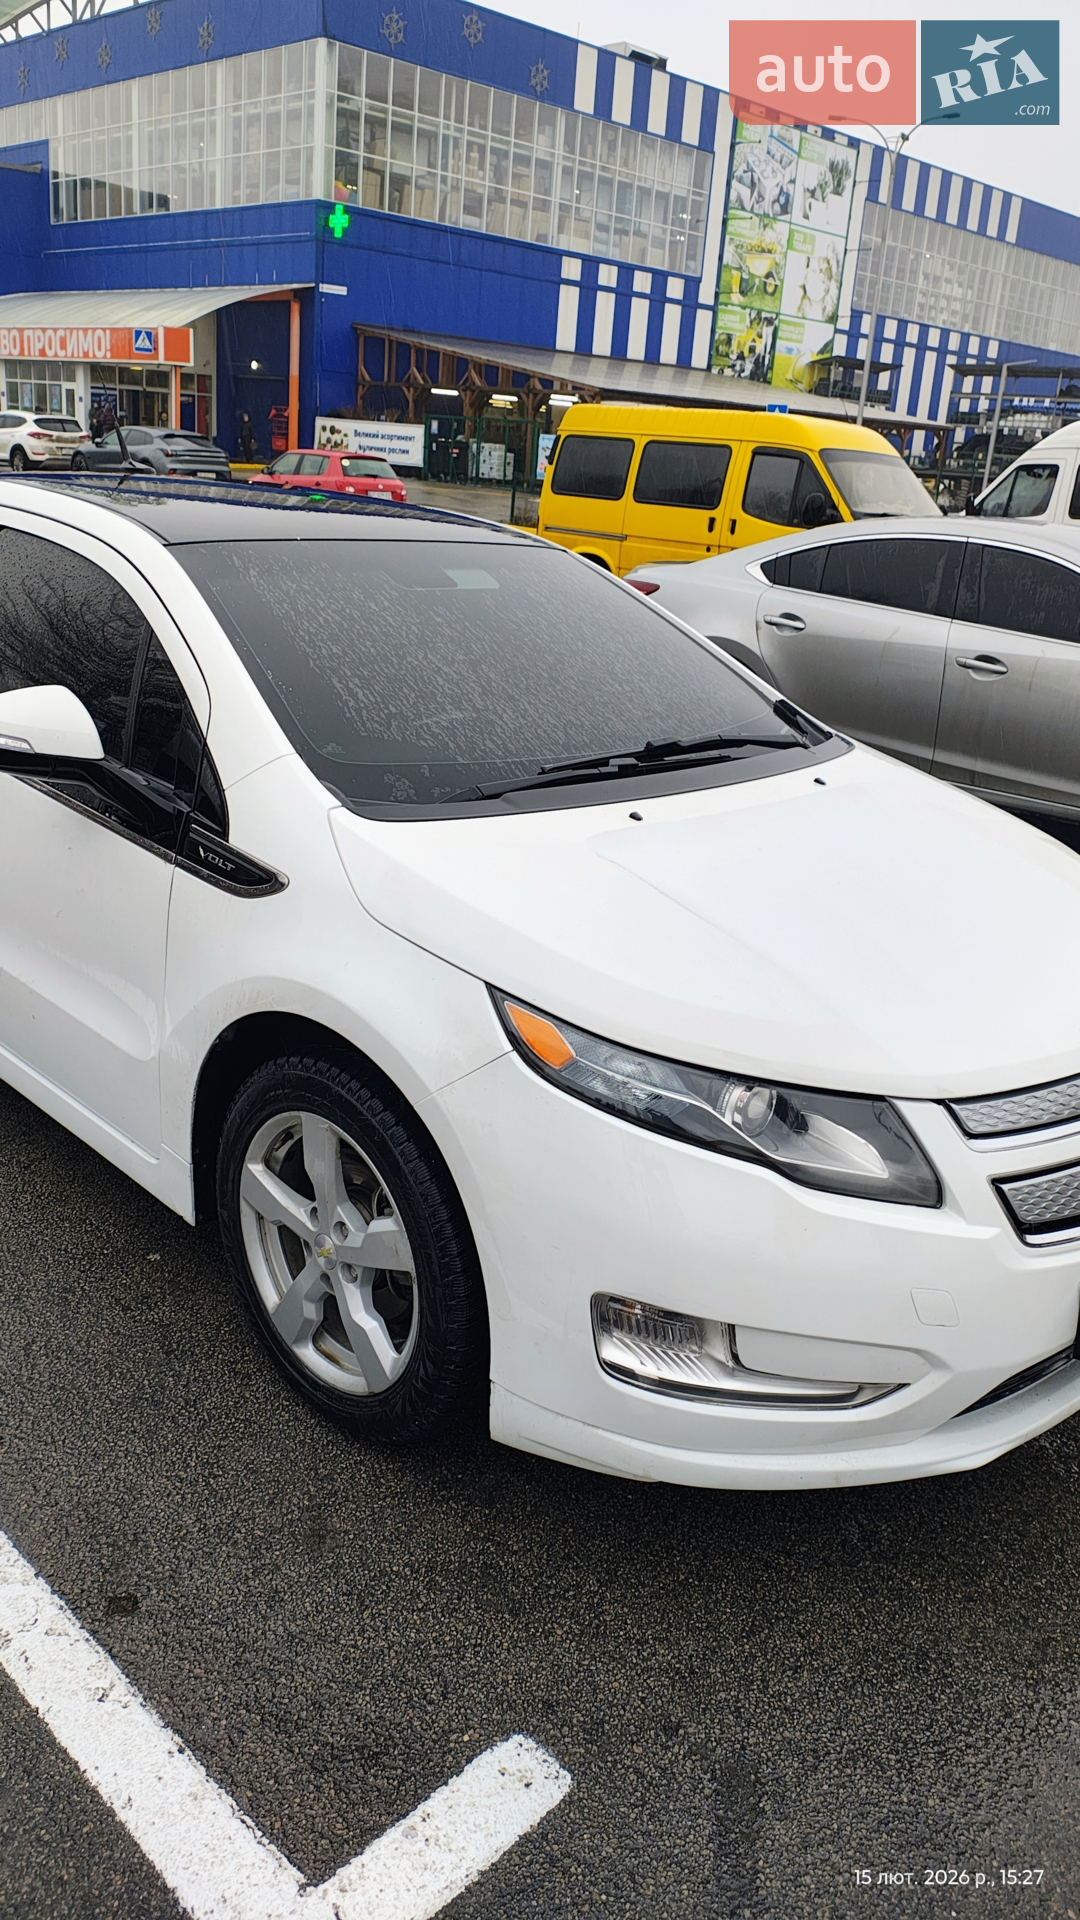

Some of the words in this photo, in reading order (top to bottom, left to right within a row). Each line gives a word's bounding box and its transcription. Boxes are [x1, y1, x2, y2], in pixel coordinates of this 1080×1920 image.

[23, 328, 111, 358] ПРОСИМО!
[354, 429, 379, 439] Великий
[380, 432, 415, 442] асортимент
[388, 447, 409, 455] рослин
[198, 845, 236, 871] VOLT
